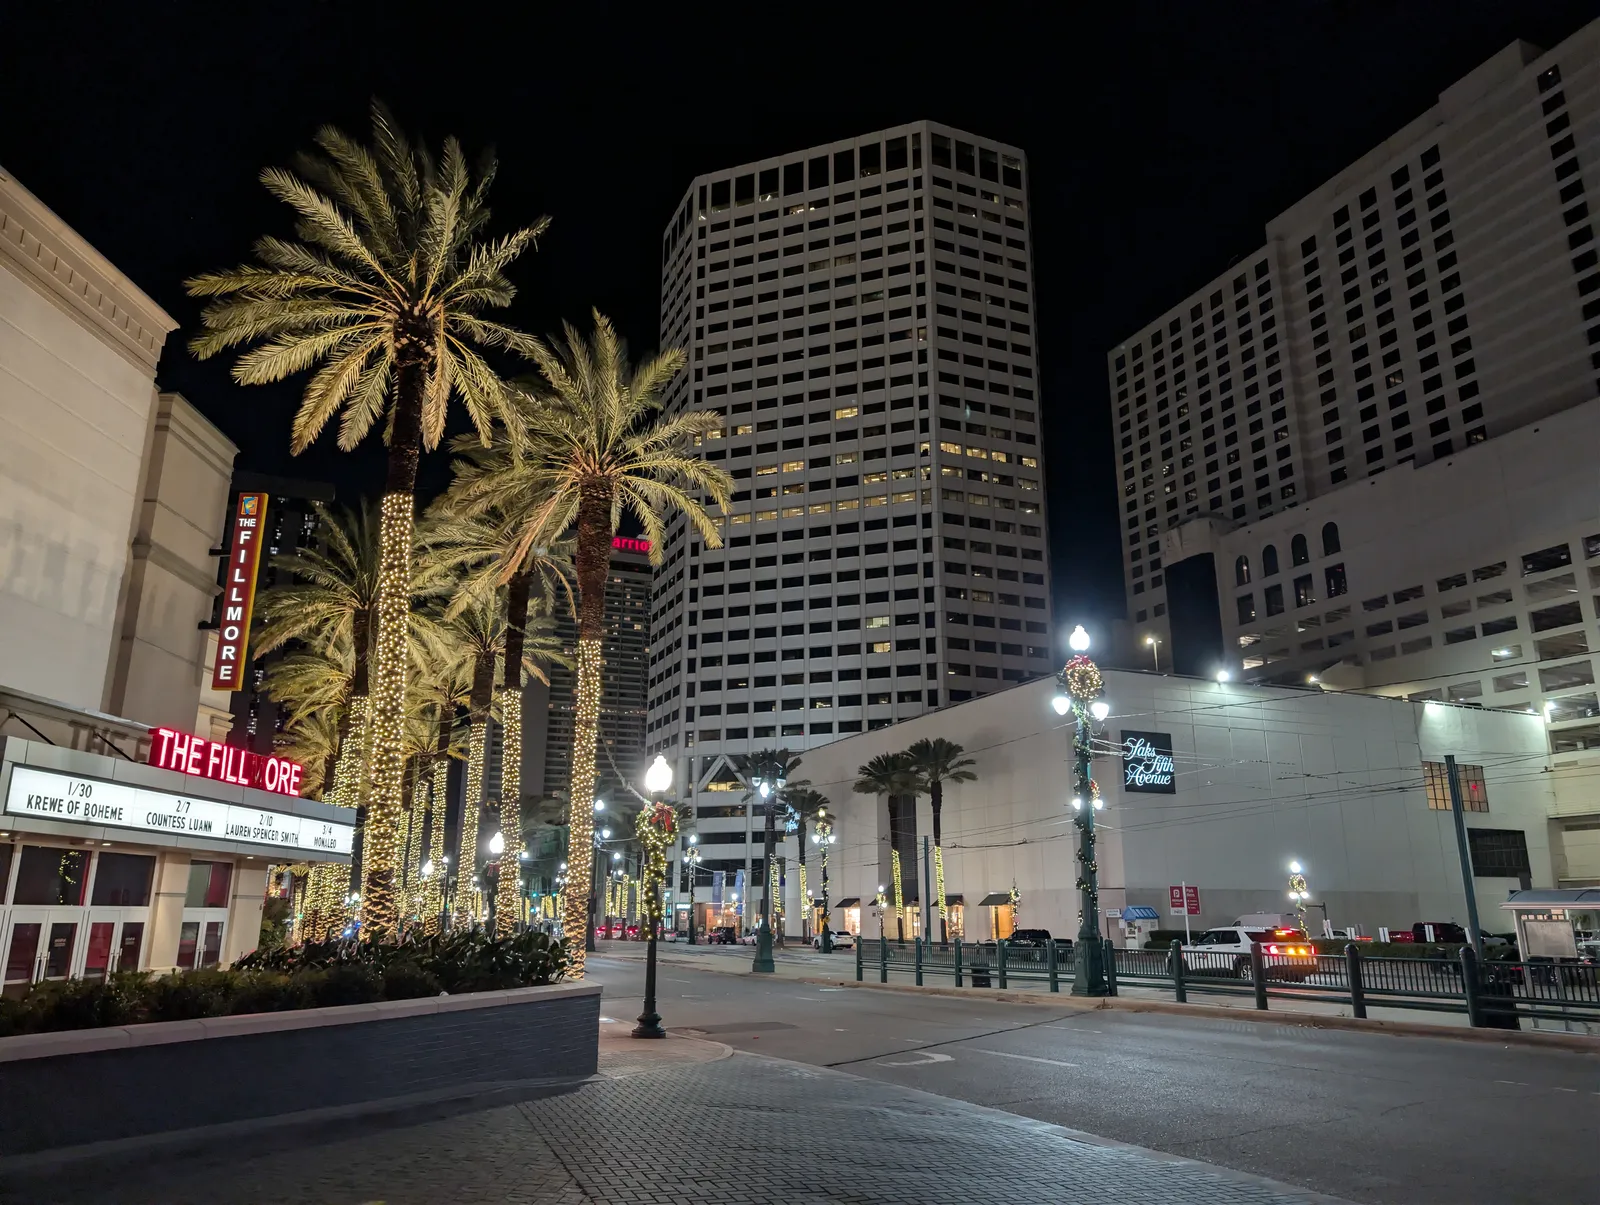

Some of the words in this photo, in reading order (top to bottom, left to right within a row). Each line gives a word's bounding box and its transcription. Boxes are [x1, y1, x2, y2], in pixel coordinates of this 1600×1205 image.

[239, 518, 256, 527] THE
[611, 537, 653, 551] arrio
[219, 531, 252, 680] FILLMORE
[158, 728, 205, 775] THE
[1123, 737, 1156, 760] Saks
[1125, 763, 1171, 786] Avenue
[1141, 754, 1175, 775] Fifth
[67, 781, 93, 798] 1/30
[26, 793, 64, 813] KREWE
[66, 800, 80, 815] OF
[83, 802, 124, 821] BOHEME
[175, 799, 191, 814] 2/7
[146, 811, 186, 829] COUNTESS
[188, 818, 213, 832] LUANN
[259, 814, 274, 827] 2/10
[322, 824, 333, 836] 3/4
[225, 823, 252, 838] LAUREN
[252, 827, 279, 841] SPENCER
[281, 831, 299, 844] SMITH
[313, 836, 337, 849] MONALEO
